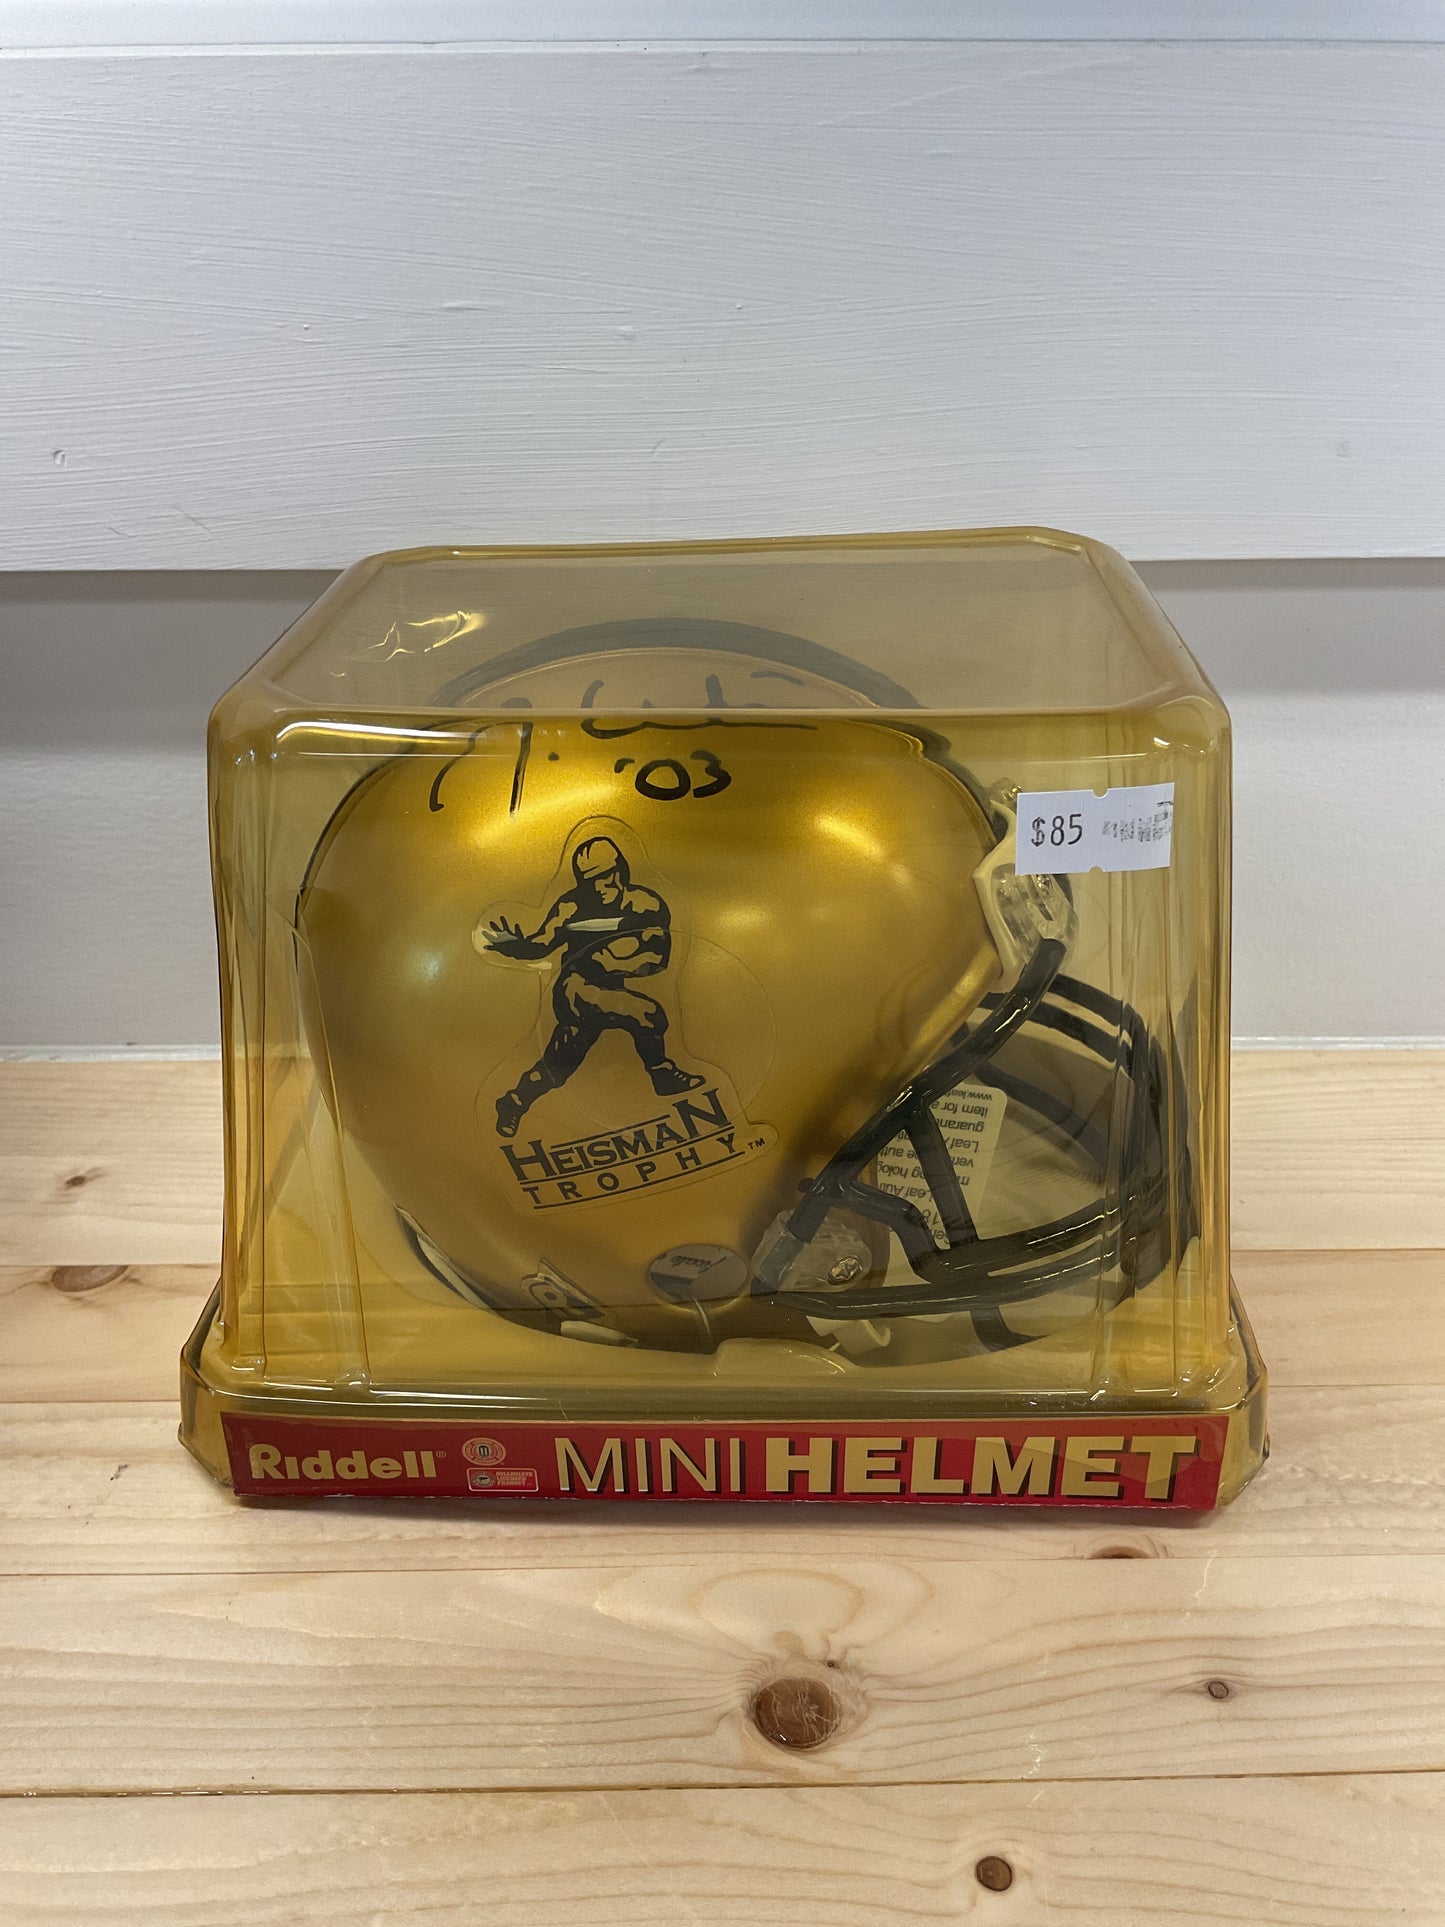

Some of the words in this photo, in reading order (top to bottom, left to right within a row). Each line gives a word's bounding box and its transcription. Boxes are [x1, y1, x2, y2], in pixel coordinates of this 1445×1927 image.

[1031, 813, 1083, 847] $85
[941, 1102, 959, 1114] for
[961, 1104, 989, 1118] item
[500, 1088, 732, 1181] HEISMAN
[949, 1138, 980, 1153] Leaf
[523, 1133, 735, 1204] TROPHY
[249, 1443, 438, 1480] Riddell
[555, 1437, 744, 1493] MINI
[765, 1435, 1200, 1500] HELMET
